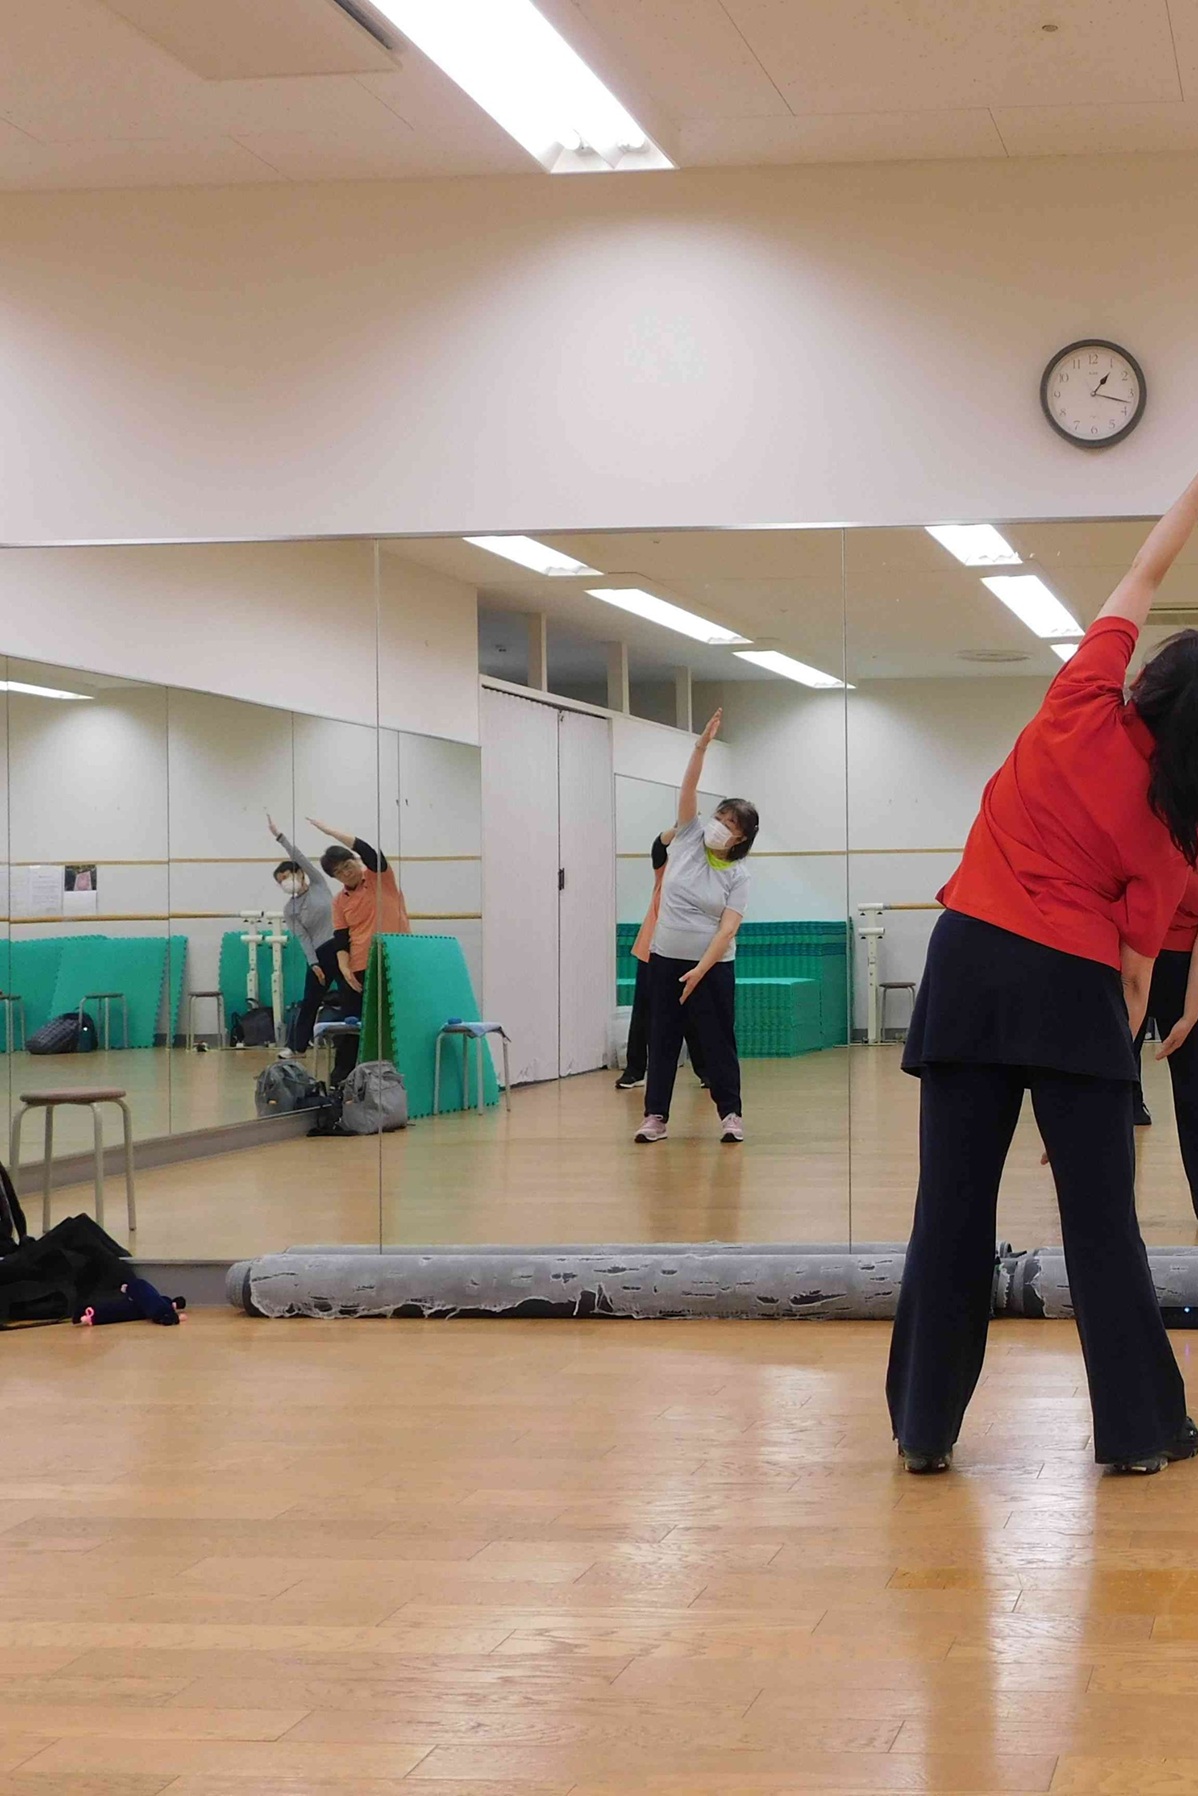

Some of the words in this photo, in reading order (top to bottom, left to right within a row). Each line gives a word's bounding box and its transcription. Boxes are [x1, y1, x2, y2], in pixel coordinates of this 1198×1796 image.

[1088, 354, 1098, 364] 12
[1073, 359, 1081, 369] 11
[1059, 373, 1069, 383] 10
[1121, 372, 1129, 381] 2
[1128, 389, 1134, 397] 3
[1121, 406, 1127, 416] 4
[1074, 421, 1080, 430] 7
[1109, 420, 1115, 428] 5
[1091, 426, 1098, 434] 6
